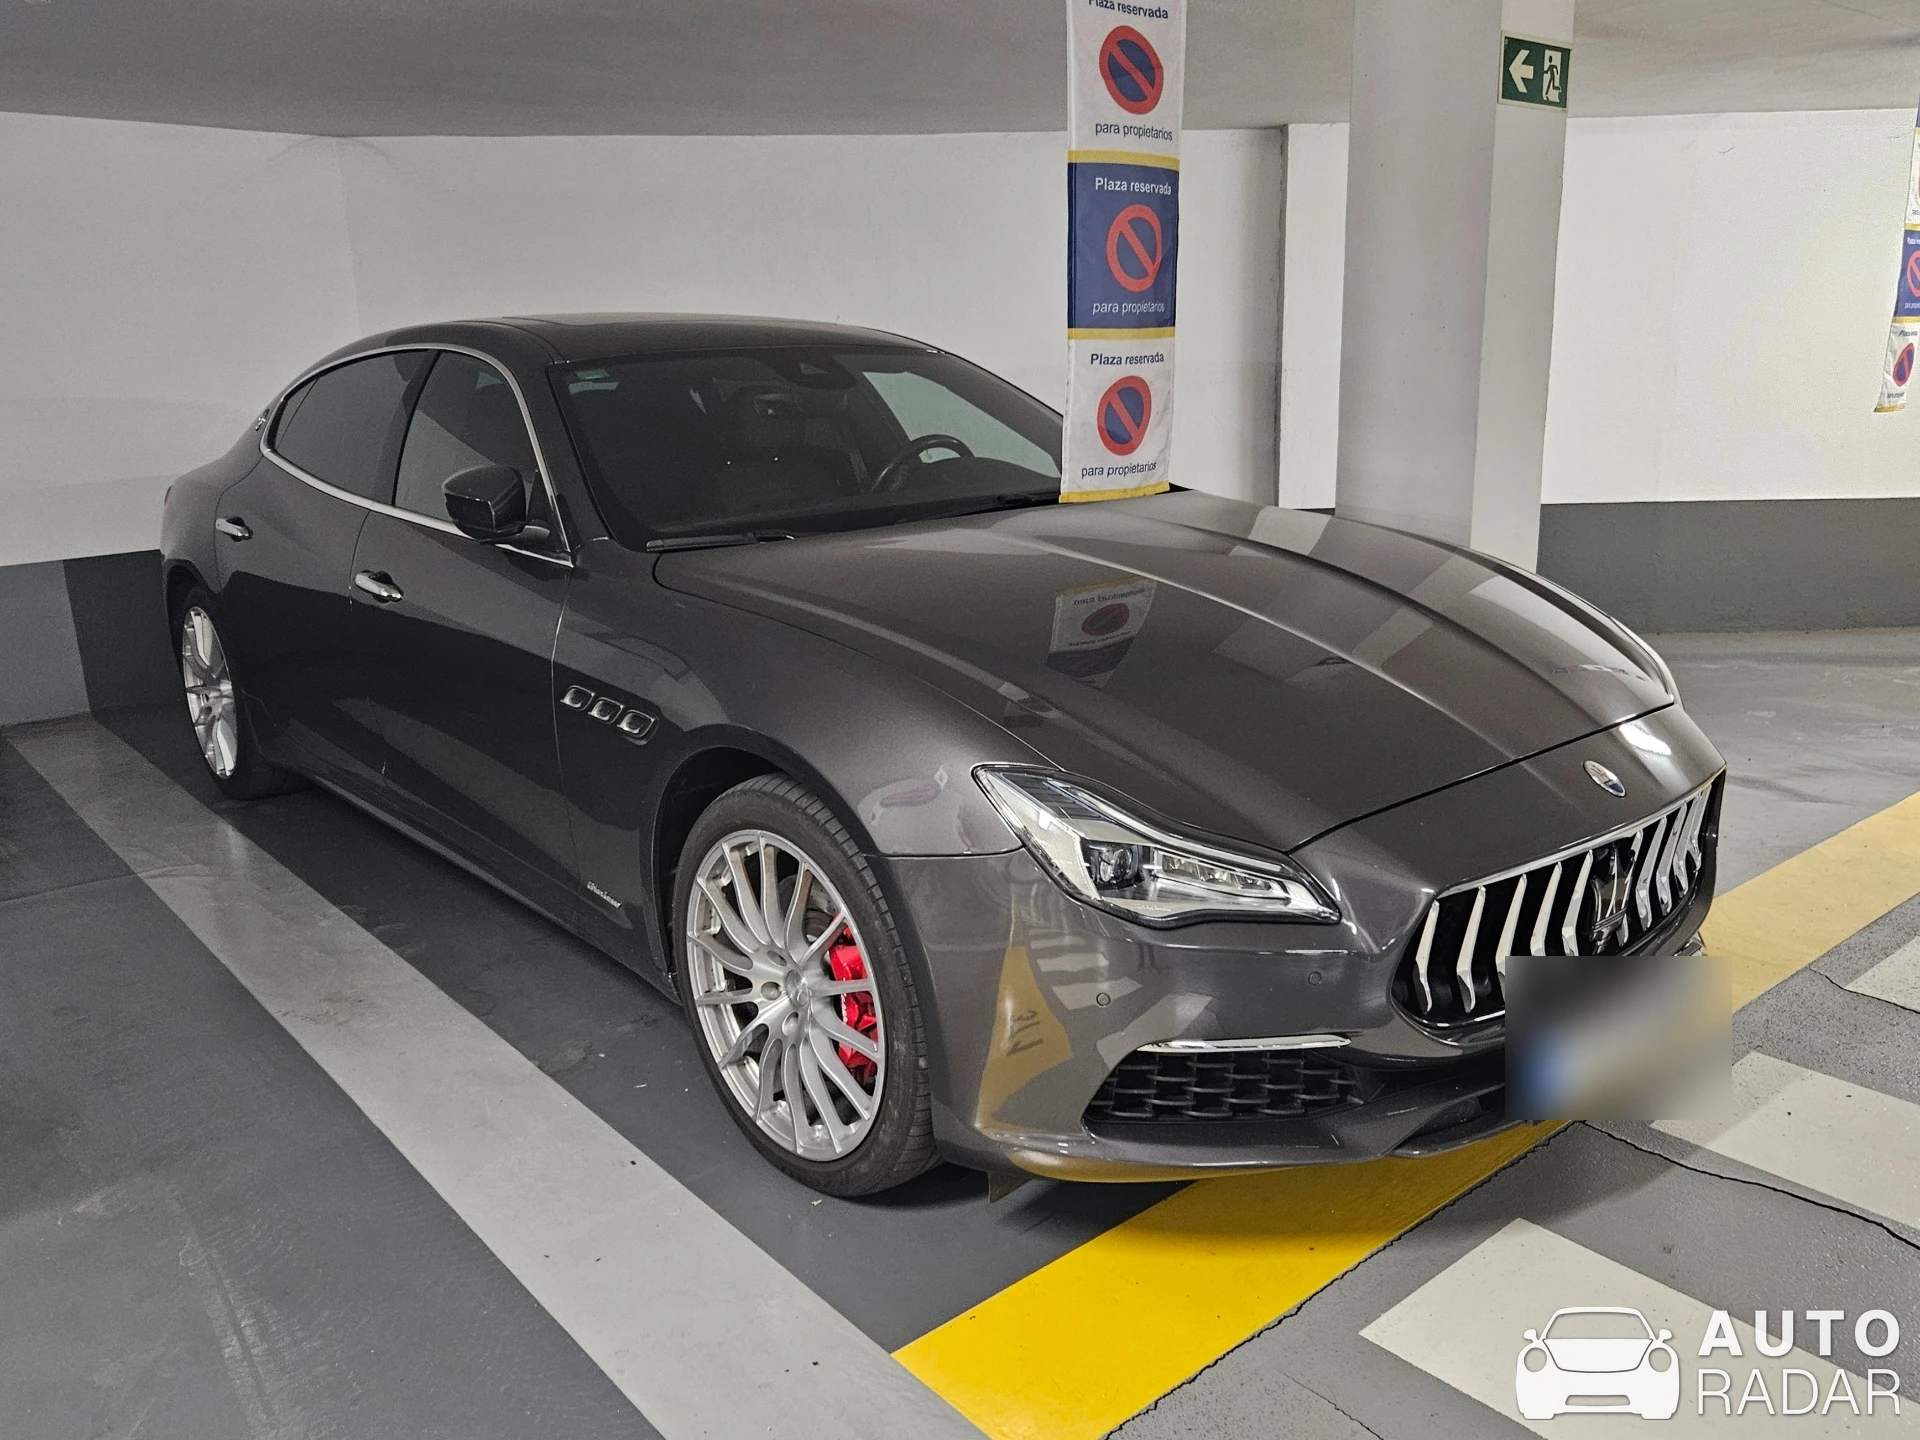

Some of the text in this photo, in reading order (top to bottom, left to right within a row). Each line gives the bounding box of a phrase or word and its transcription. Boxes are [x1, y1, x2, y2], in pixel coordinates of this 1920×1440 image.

[1117, 2, 1169, 19] reservada
[1095, 123, 1173, 141] para propietarios
[1095, 177, 1172, 195] Plaza reservada
[1092, 301, 1165, 316] para propietarios
[1090, 351, 1165, 365] Plaza reservada
[1081, 461, 1157, 479] para propietarios
